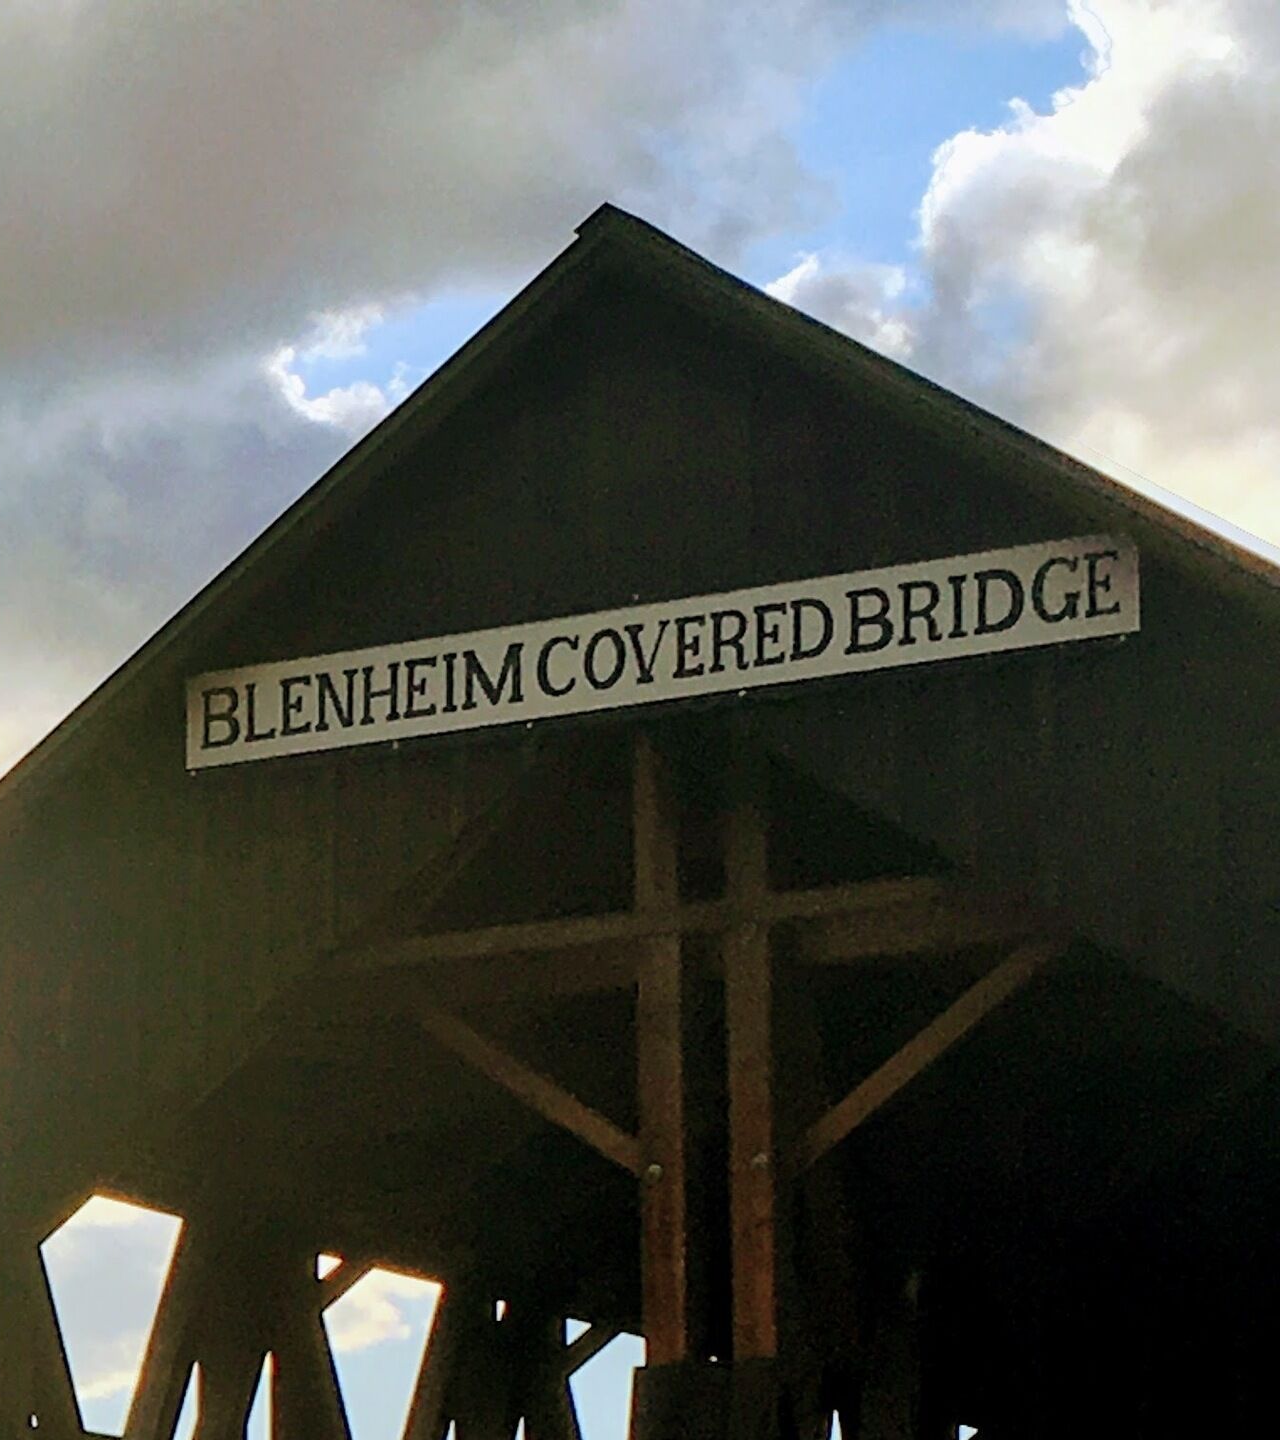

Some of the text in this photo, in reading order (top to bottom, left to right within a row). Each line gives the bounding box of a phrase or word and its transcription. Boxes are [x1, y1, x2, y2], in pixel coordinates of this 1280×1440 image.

[200, 550, 1121, 750] BLENHEIM COVERED BRIDGE
